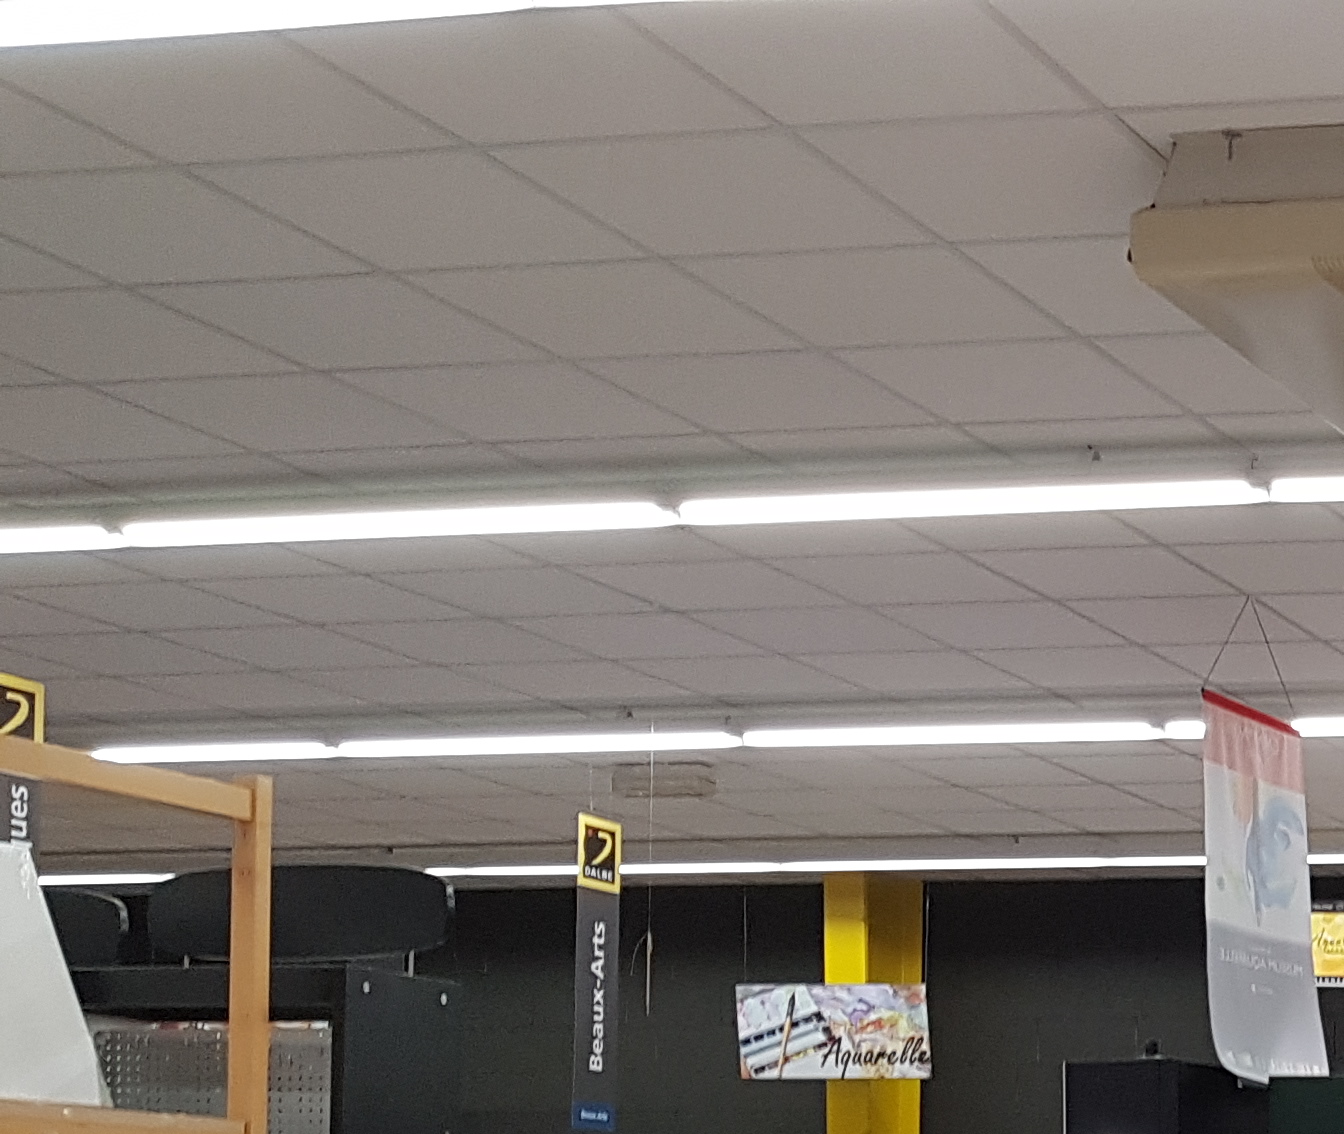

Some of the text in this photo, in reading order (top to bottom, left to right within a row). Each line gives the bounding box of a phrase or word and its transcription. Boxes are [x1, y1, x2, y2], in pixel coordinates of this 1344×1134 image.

[10, 783, 29, 846] ues
[584, 865, 614, 882] DALBE
[588, 920, 606, 1073] Beaux-Arts
[820, 1035, 931, 1080] Aquarelle
